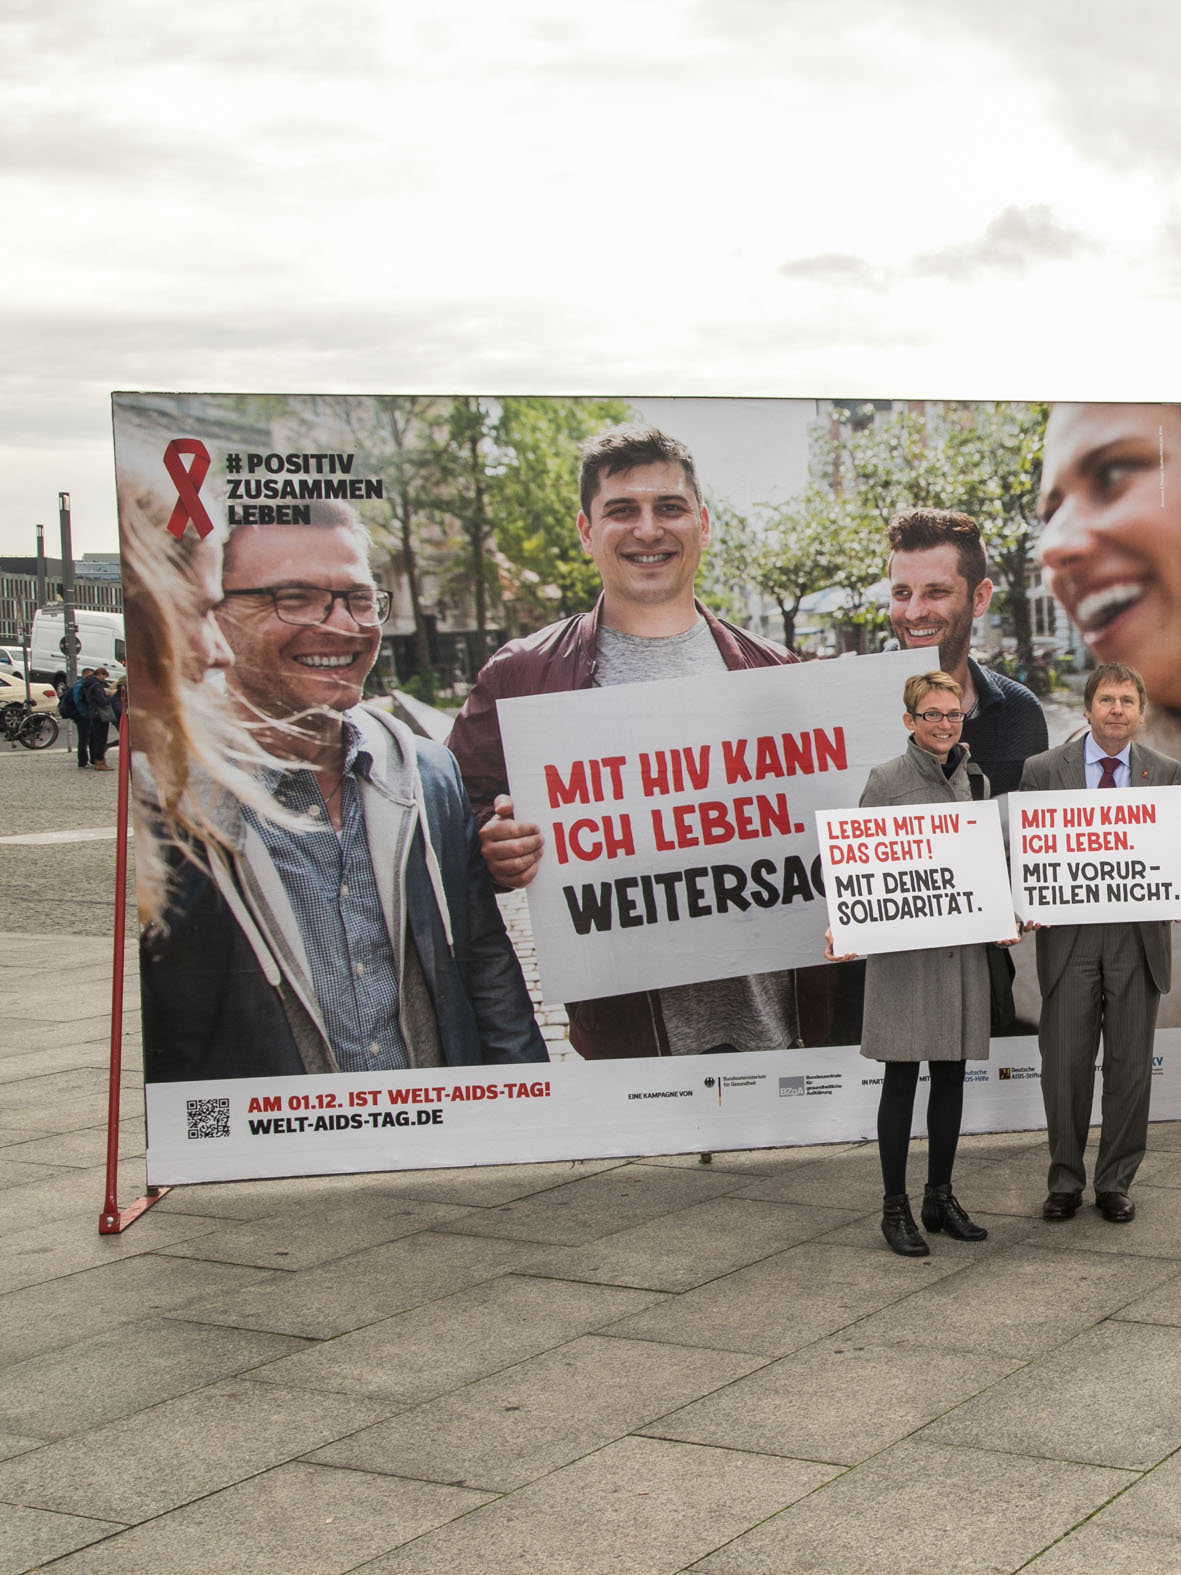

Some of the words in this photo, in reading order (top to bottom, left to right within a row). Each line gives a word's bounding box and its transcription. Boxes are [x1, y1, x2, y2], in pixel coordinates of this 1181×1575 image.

[227, 479, 383, 499] ZUSAMMEN
[228, 505, 311, 525] LEBEN
[544, 756, 626, 808] MIT
[639, 745, 711, 797] HIV
[722, 727, 848, 785] KANN
[553, 814, 635, 864] ICH
[651, 793, 805, 851] LEBEN.
[827, 818, 886, 839] LEBEN
[893, 816, 924, 836] MIT
[1021, 809, 1057, 829] MIT
[1063, 808, 1095, 827] HIV
[1100, 804, 1156, 825] KANN
[829, 843, 869, 865] DAS
[875, 839, 933, 862] GEHT!
[1023, 834, 1057, 854] ICH
[1066, 831, 1134, 852] LEBEN.
[835, 874, 875, 898] MIT
[883, 867, 955, 894] DEINER
[1023, 863, 1061, 882] MIT
[1024, 884, 1100, 905] TEILEN
[1107, 883, 1180, 902] NICHT.
[837, 891, 982, 925] SOLIDARITÄT.
[248, 1096, 281, 1113] AM
[288, 1093, 342, 1111] 01.12.
[349, 1090, 382, 1108] IST
[388, 1082, 551, 1105] WELT-AIDS-TAG!
[249, 1109, 444, 1135] WELT-AIDS-TAG.DE
